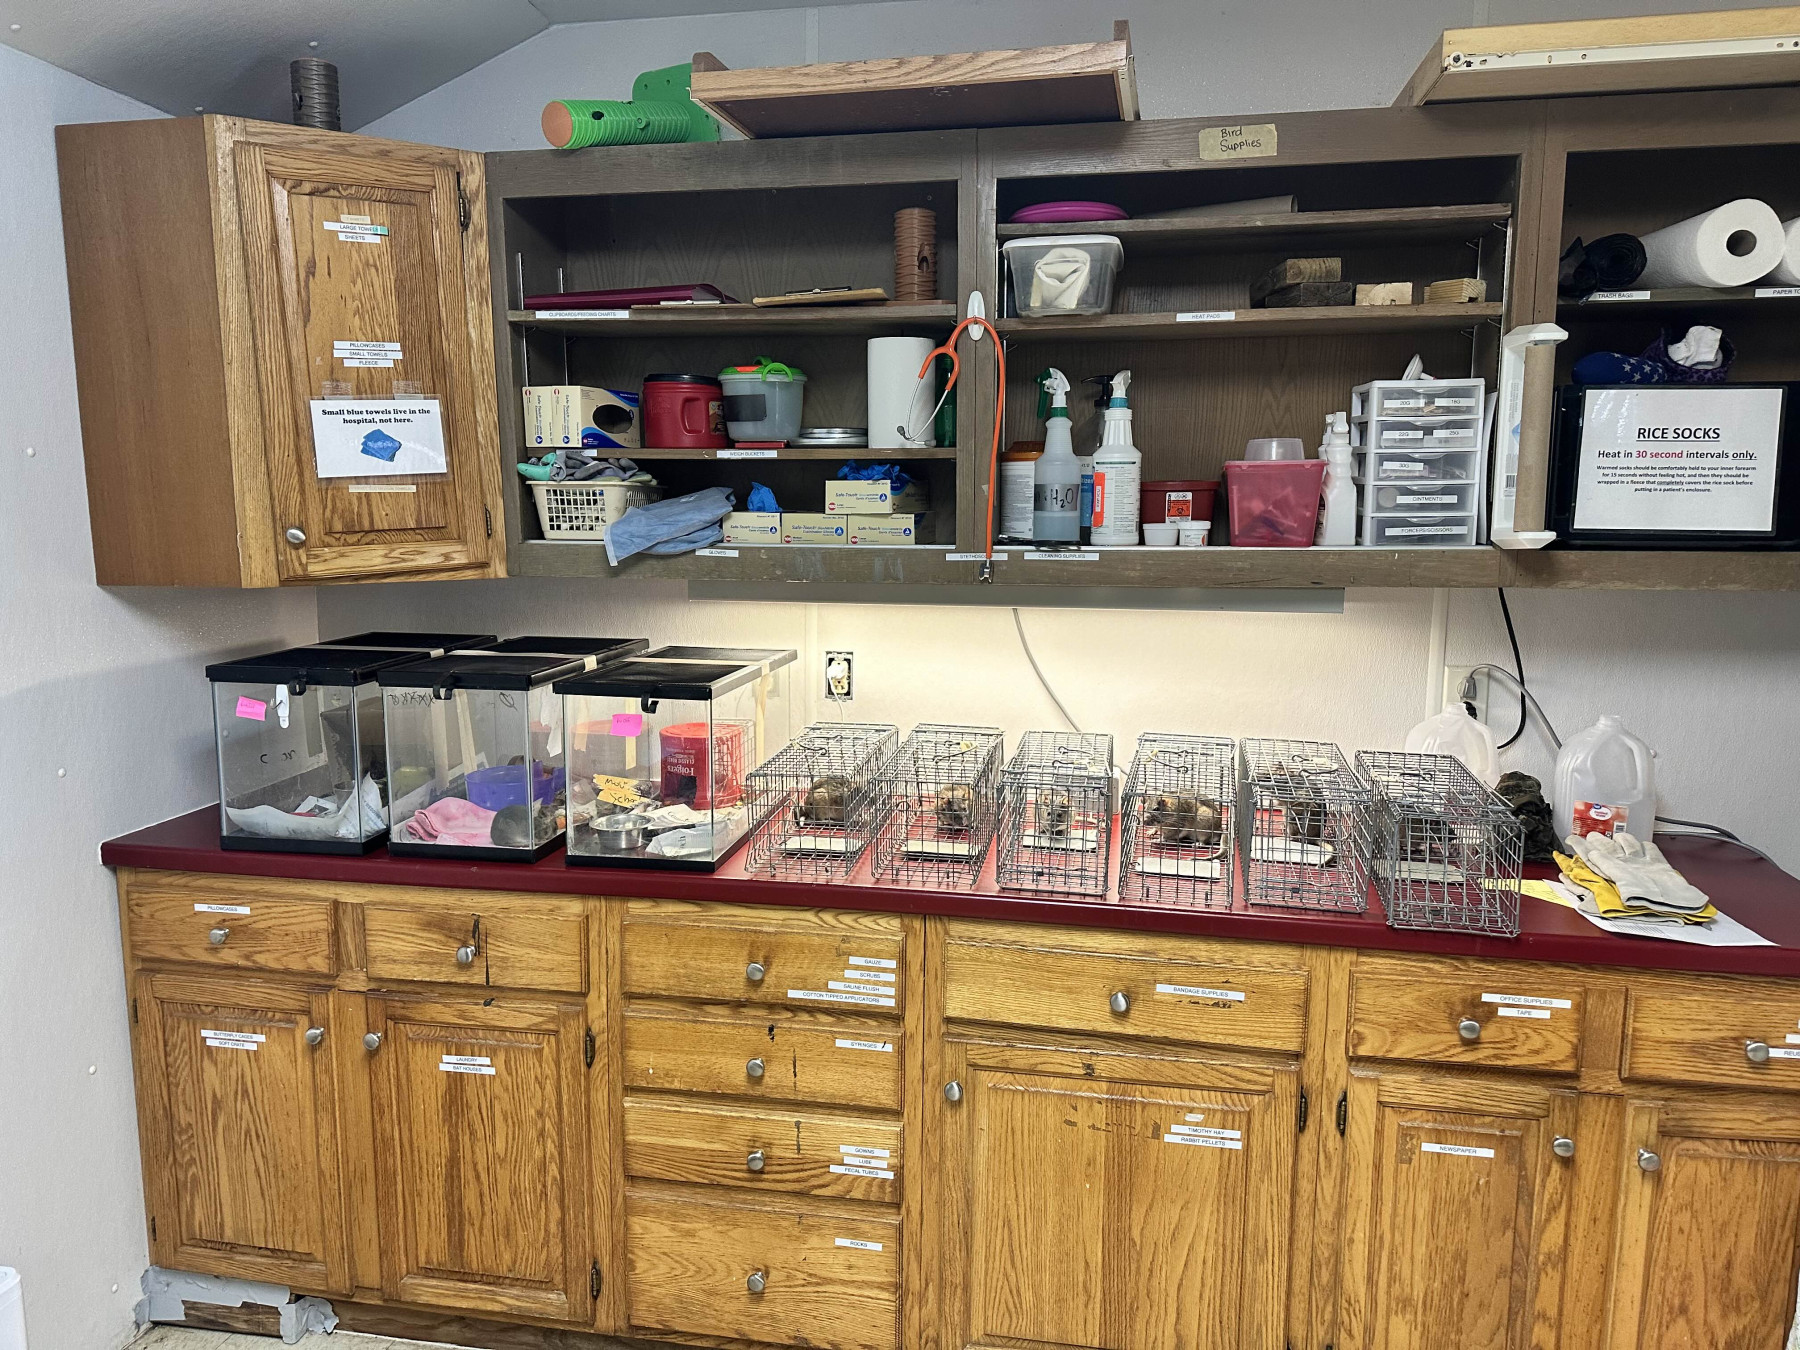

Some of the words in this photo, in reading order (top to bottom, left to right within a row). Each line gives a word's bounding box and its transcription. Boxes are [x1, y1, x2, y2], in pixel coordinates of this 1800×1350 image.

[1220, 126, 1242, 138] Bird
[1220, 138, 1262, 152] Supplies
[321, 408, 345, 416] Small
[342, 417, 378, 425] hospital,
[1636, 427, 1669, 440] RICE
[1672, 427, 1721, 440] SOCKS
[1597, 449, 1621, 459] Heat
[1623, 450, 1633, 459] in
[1635, 450, 1648, 459] 30
[1649, 450, 1684, 459] second
[1686, 450, 1730, 459] intervals
[1731, 450, 1758, 461] only.
[1173, 986, 1200, 995] BANDAGE
[1200, 989, 1229, 997] SUPPLIES
[844, 995, 880, 1003] APPLICATORS
[1523, 997, 1553, 1005] SUPPLIES
[850, 1041, 877, 1049] SYRINGES
[854, 1147, 875, 1155] GOWNS
[1439, 1146, 1477, 1154] NEWSPAPER
[849, 1240, 868, 1248] ROCKS
